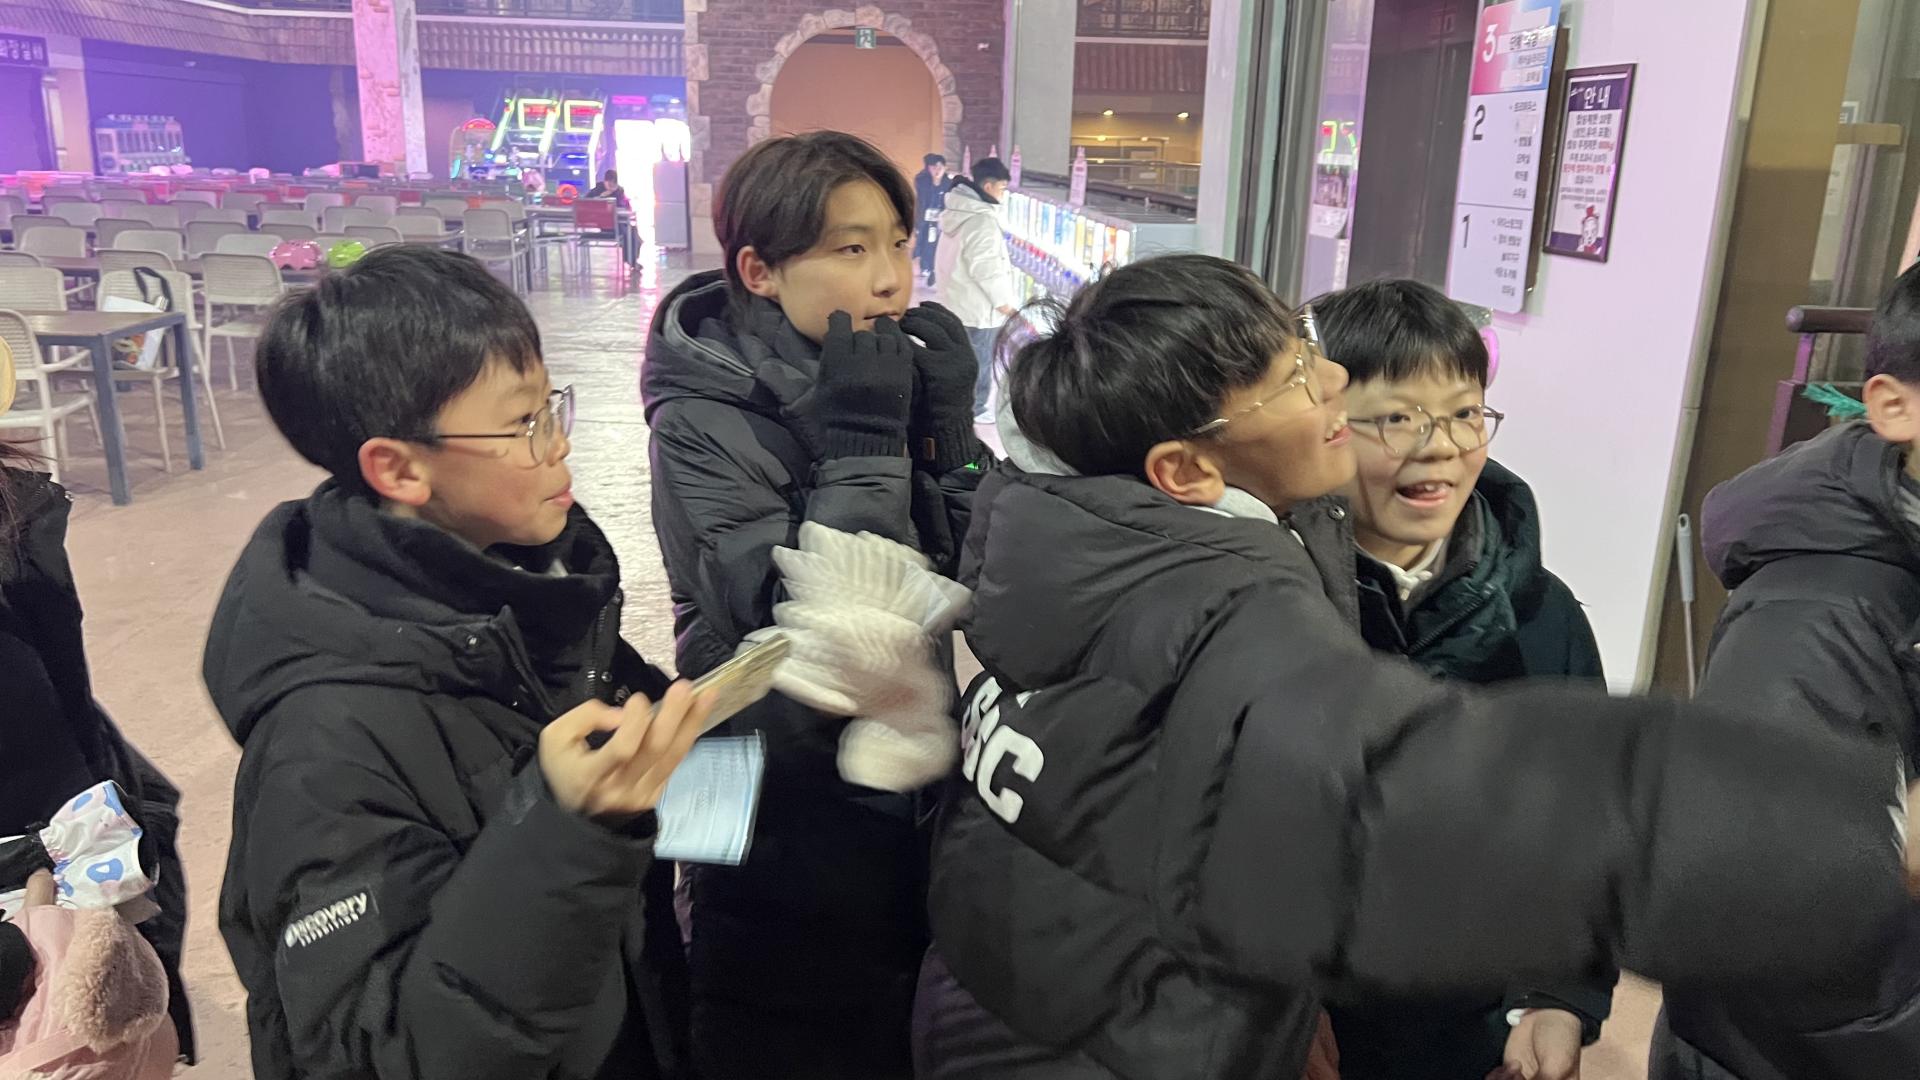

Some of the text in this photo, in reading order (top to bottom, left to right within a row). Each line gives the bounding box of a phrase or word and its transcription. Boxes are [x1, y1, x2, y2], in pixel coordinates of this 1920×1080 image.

[1483, 24, 1498, 63] 3
[1472, 104, 1486, 141] 2
[1461, 214, 1471, 249] 1
